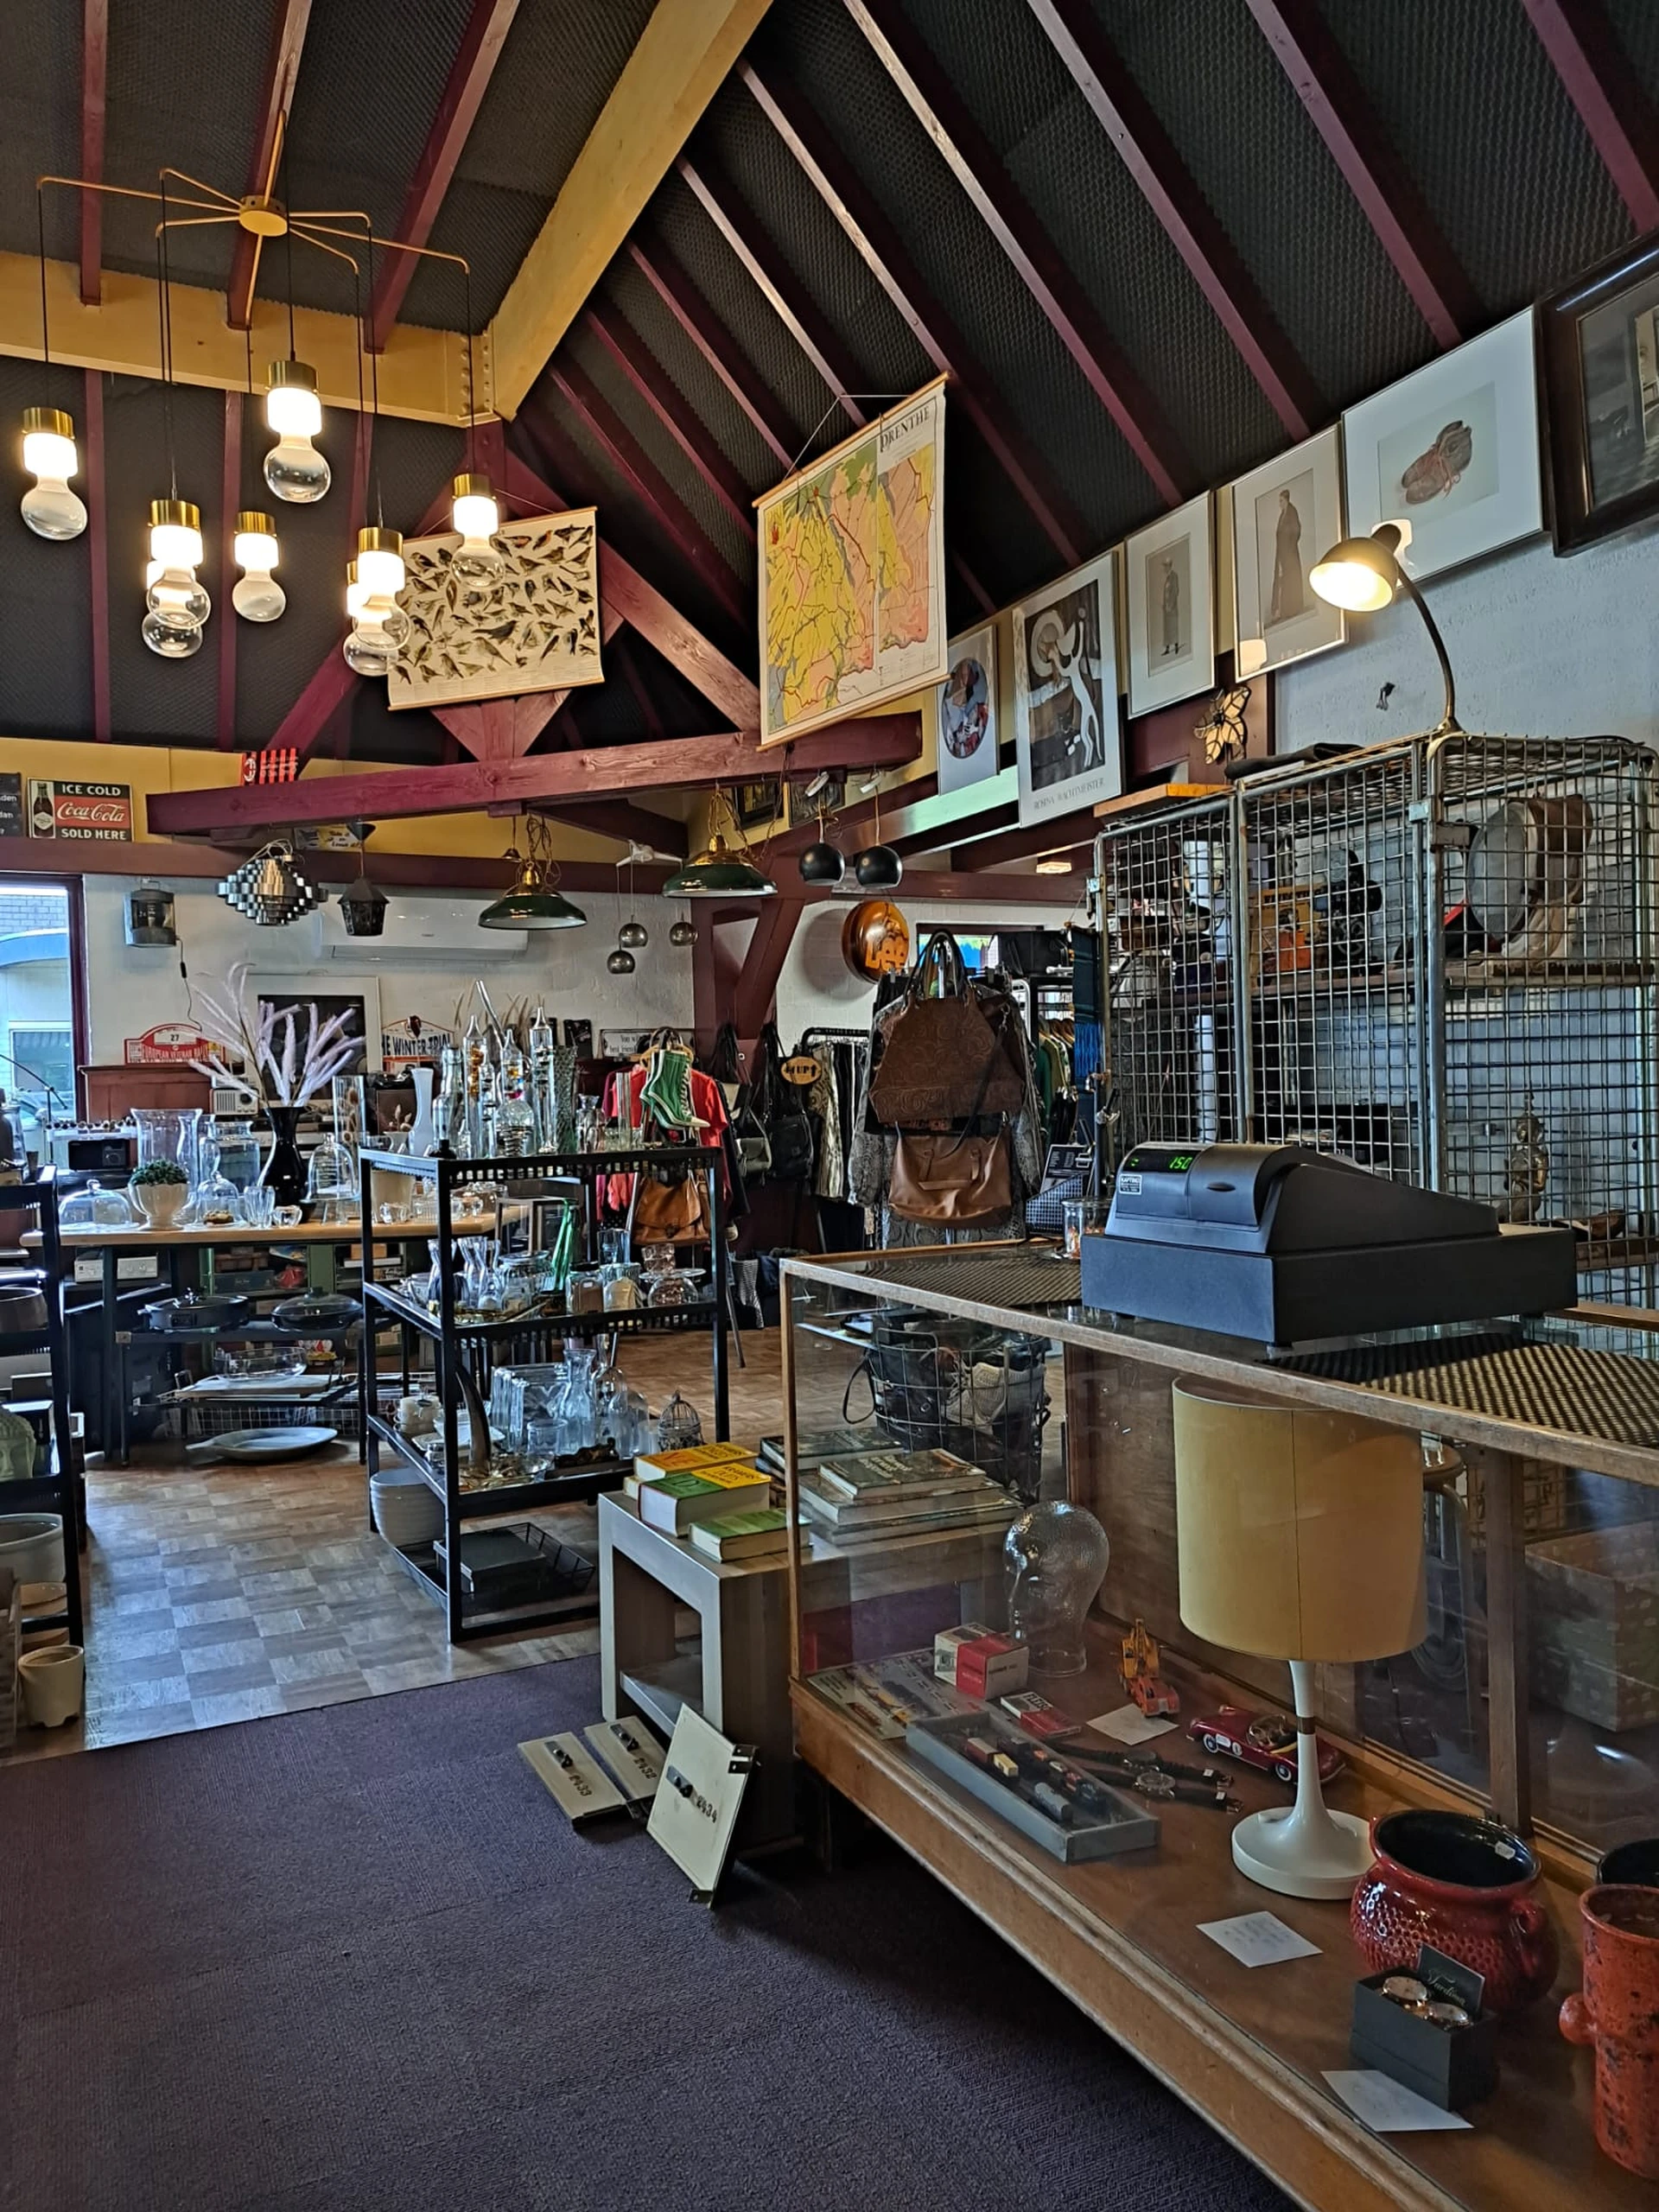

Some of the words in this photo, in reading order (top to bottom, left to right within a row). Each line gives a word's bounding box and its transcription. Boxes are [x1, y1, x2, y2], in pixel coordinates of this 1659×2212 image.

[880, 405, 930, 448] DRENTHE
[62, 784, 82, 794] ICE
[87, 785, 120, 796] COLD
[61, 828, 92, 839] SOLD
[95, 830, 126, 841] HERE
[170, 1033, 180, 1042] 27
[696, 1796, 718, 1824] 2434
